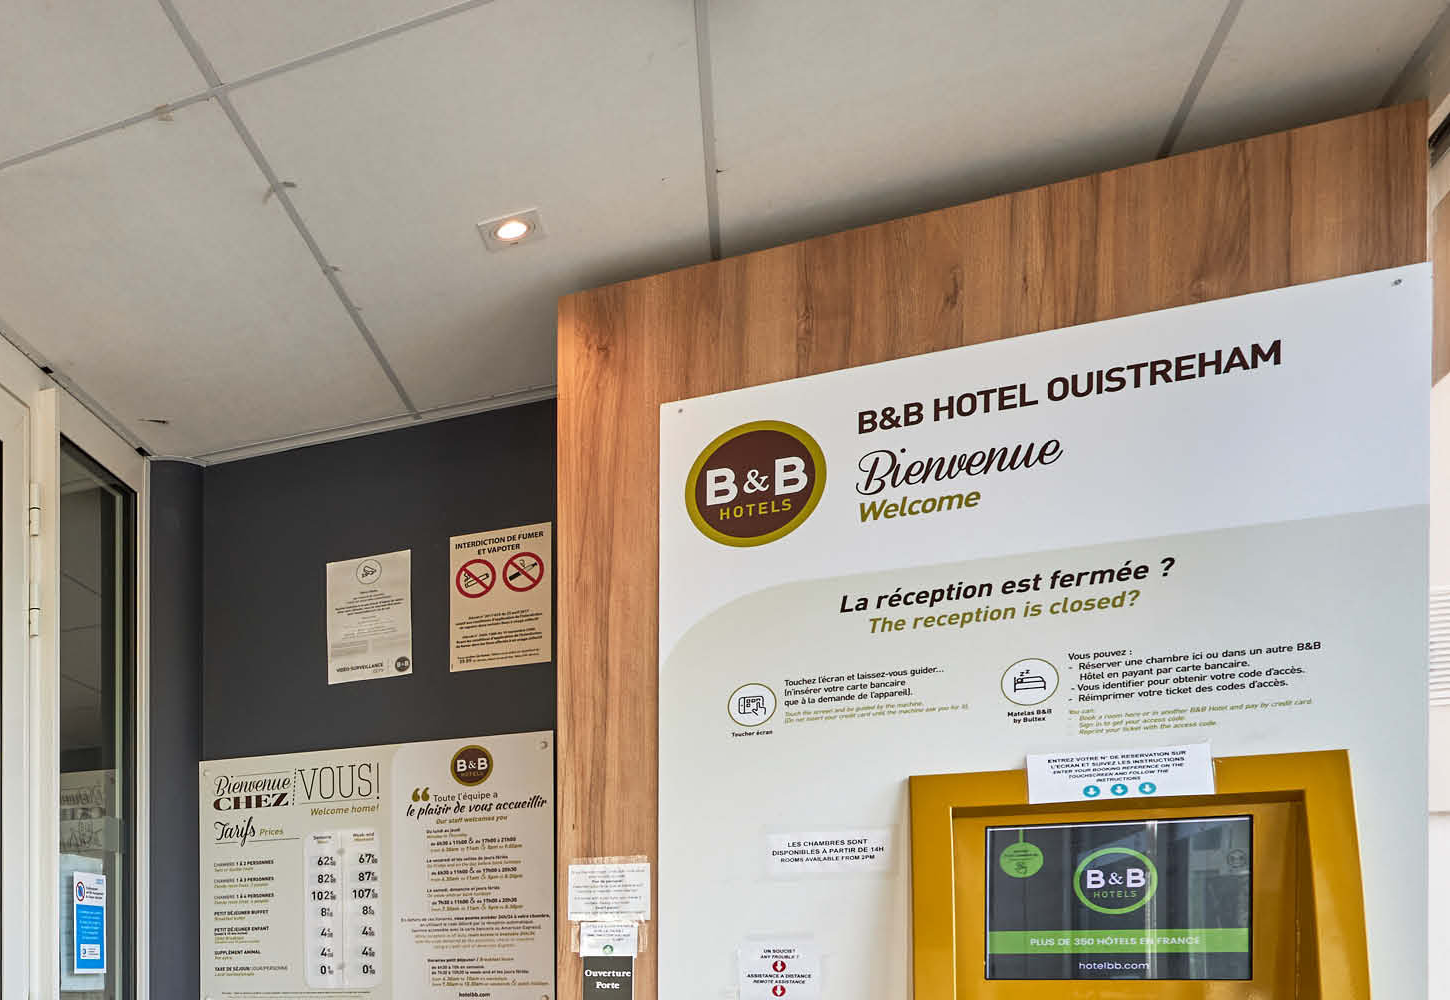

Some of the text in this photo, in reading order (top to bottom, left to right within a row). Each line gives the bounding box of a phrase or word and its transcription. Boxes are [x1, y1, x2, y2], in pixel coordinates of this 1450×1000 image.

[858, 339, 1281, 435] B&B HOTEL OUISTREHAM
[855, 439, 1064, 496] Bienvenue
[706, 456, 808, 506] B&B
[719, 498, 792, 521] HOTELS
[858, 490, 981, 523] Welcome
[455, 531, 544, 549] INTERDICTION DE FUMER
[487, 543, 520, 553] VAPOTER
[839, 556, 1175, 613] La réception est fermée ?
[869, 589, 1141, 634] The reception is closed?
[1078, 660, 1122, 670] Réserver
[1124, 658, 1143, 666] une
[1145, 653, 1189, 664] chambre
[1192, 651, 1203, 661] ici
[1221, 649, 1246, 658] dans
[1265, 645, 1293, 654] autre
[1296, 641, 1321, 651] B&B
[784, 677, 817, 686] Touchez
[818, 675, 845, 684] l'écran
[846, 673, 855, 681] et
[856, 669, 908, 680] laissez-vous
[823, 685, 845, 693] votre
[846, 683, 868, 691] carte
[869, 679, 906, 689] bancaire
[784, 699, 799, 708] que
[800, 696, 806, 705] à
[807, 696, 816, 704] la
[817, 693, 856, 703] demande
[857, 692, 868, 700] de
[456, 757, 488, 772] B&B
[214, 775, 291, 796] Bienvenue
[298, 763, 380, 800] VOUS!
[214, 793, 289, 811] CHEZ
[457, 792, 490, 803] l'équipe
[310, 803, 380, 816] Welcome home!
[406, 795, 547, 820] le plaisir de vous accueillir
[214, 816, 284, 846] Tarifs Prices
[803, 839, 845, 847] CHAMBRES
[846, 838, 868, 846] SONT
[771, 848, 820, 856] DISPONIBLES
[1086, 868, 1146, 889] B&B
[1094, 890, 1137, 899] HOTELS
[1030, 937, 1055, 946] PLUS
[1057, 937, 1070, 946] DE
[1073, 937, 1094, 946] 350
[1097, 935, 1137, 946] HÔTELS
[1157, 936, 1201, 946] FRANCE
[1078, 961, 1150, 971] hotelbb.com
[596, 981, 620, 989] Porte
